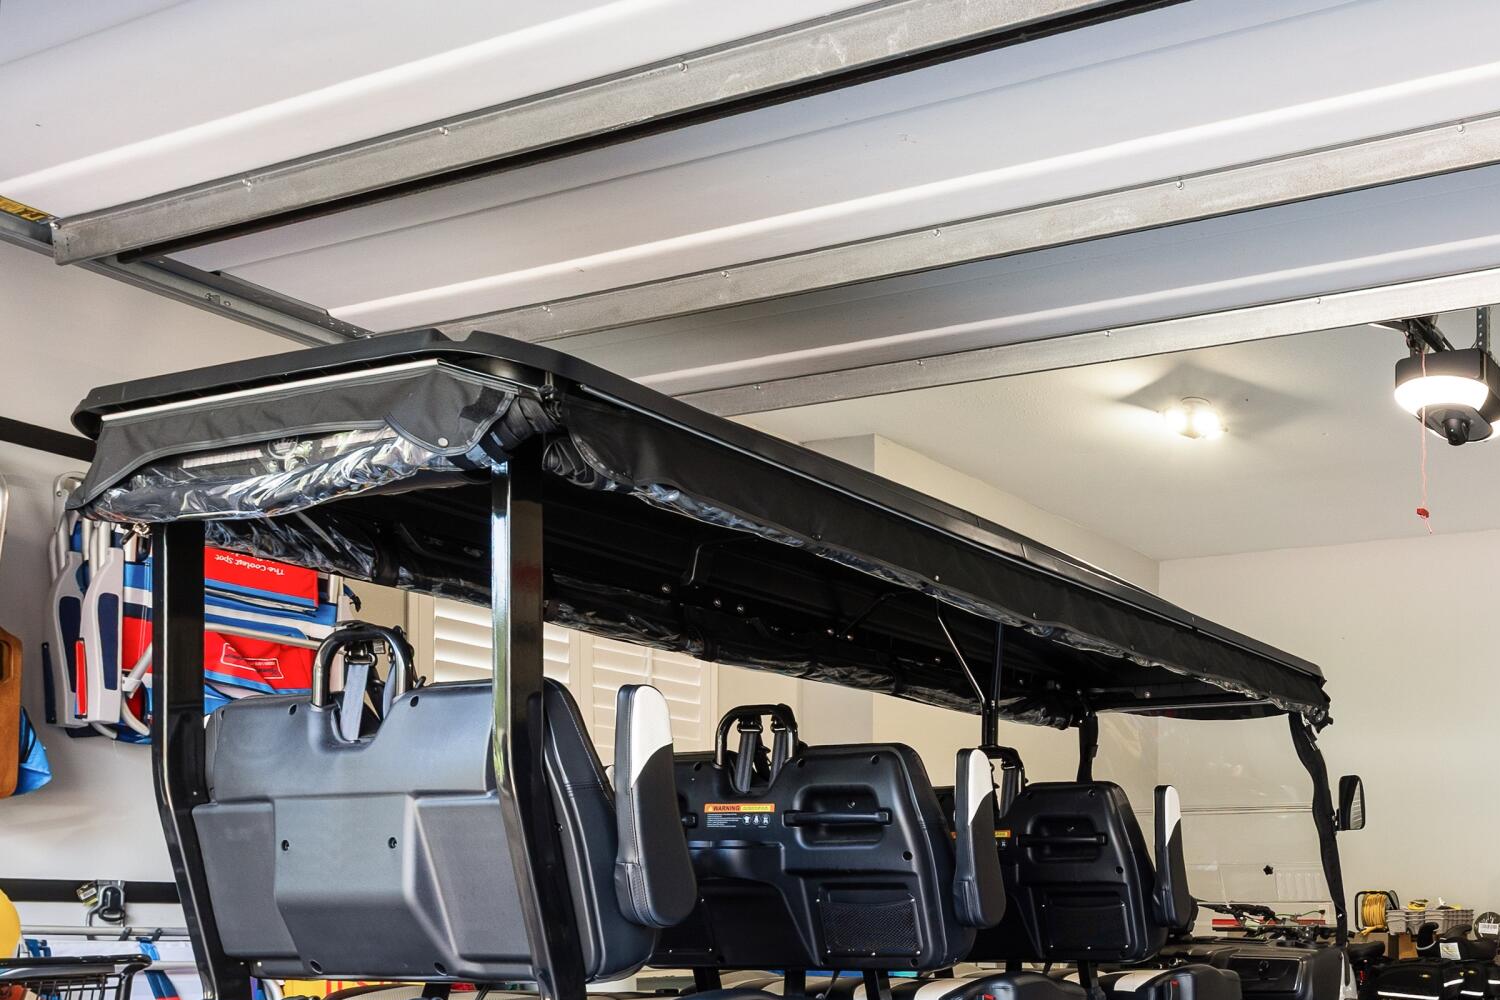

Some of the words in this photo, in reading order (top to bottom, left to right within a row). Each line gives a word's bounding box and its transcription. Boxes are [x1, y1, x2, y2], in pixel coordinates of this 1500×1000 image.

[214, 553, 234, 565] Spot
[234, 558, 267, 572] Coolest
[266, 565, 285, 576] The
